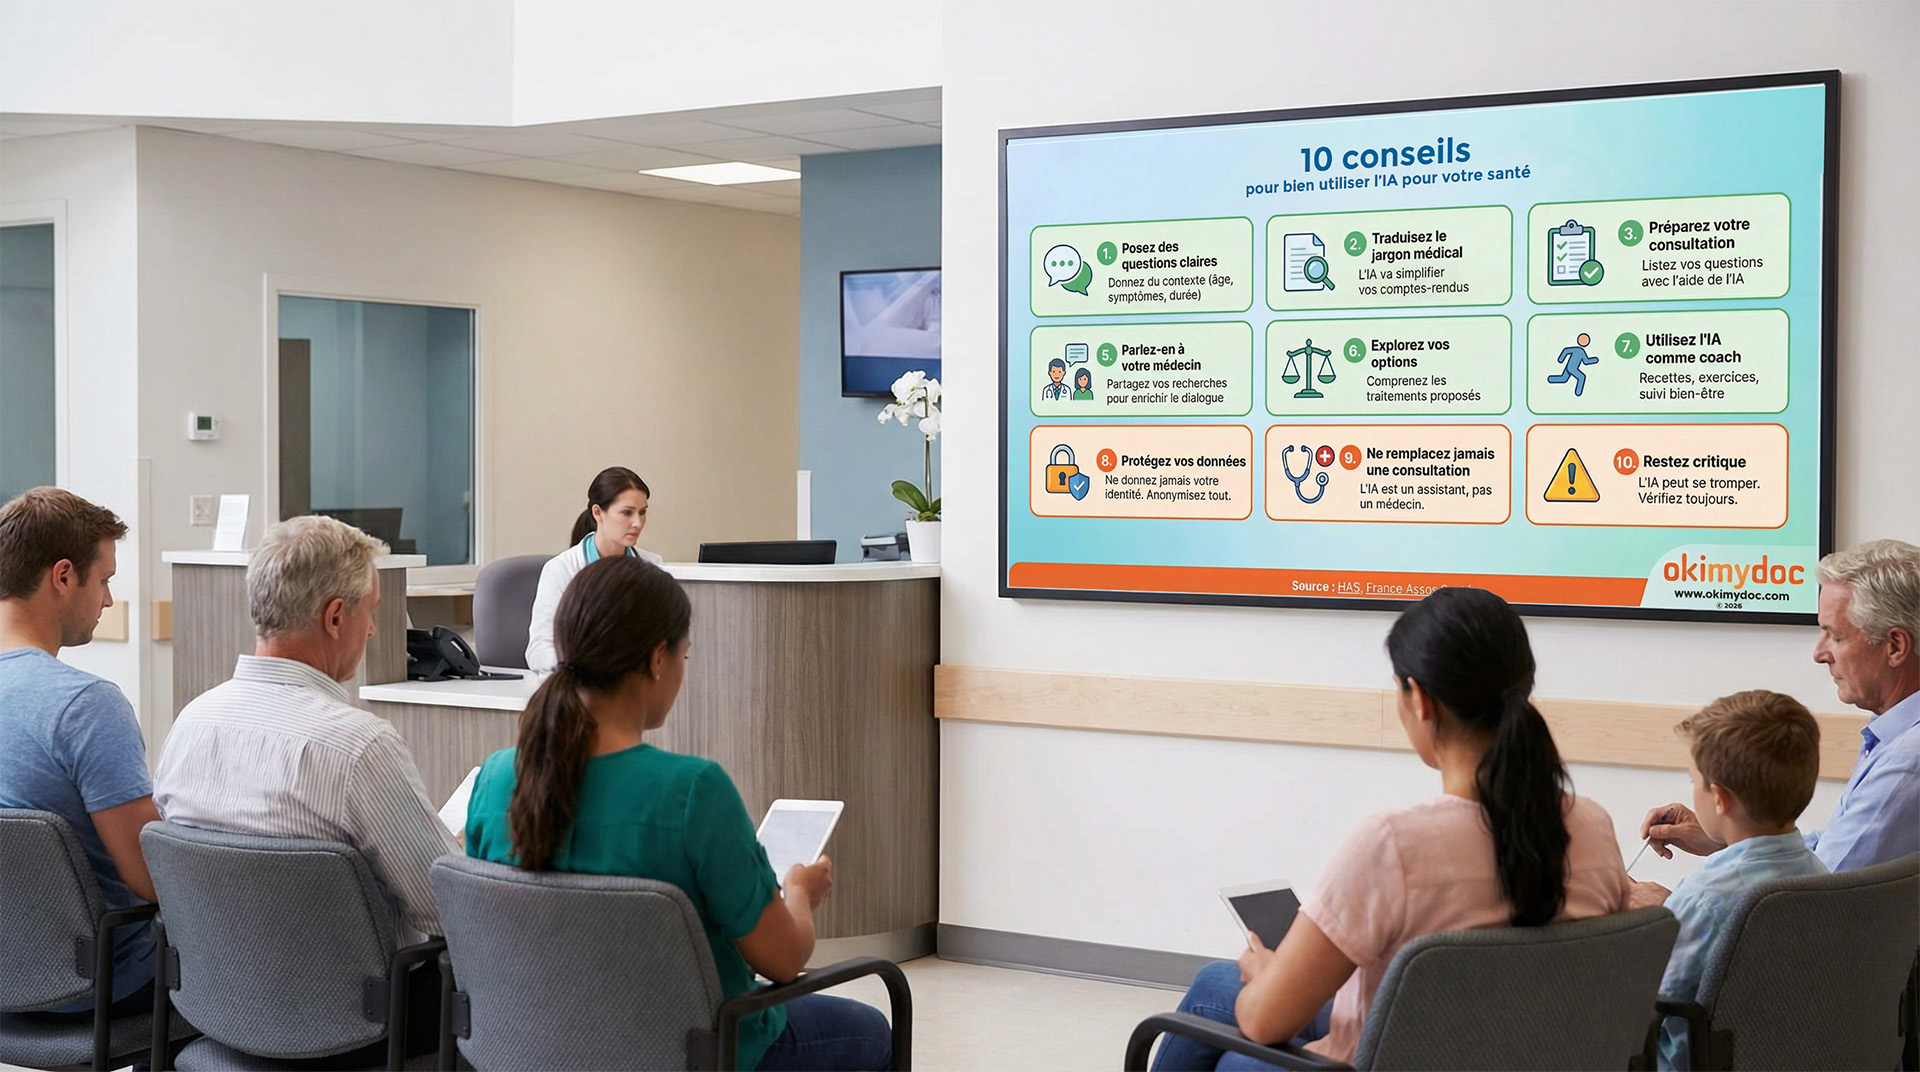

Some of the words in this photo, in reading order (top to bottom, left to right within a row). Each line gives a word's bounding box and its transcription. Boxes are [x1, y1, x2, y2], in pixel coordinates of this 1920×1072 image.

[1300, 146, 1333, 173] 10
[1342, 137, 1471, 169] conseils
[1246, 182, 1279, 197] pour
[1283, 180, 1314, 193] bien
[1319, 176, 1370, 190] utiliser
[1402, 173, 1438, 188] pour
[1442, 170, 1483, 182] votre
[1487, 165, 1531, 180] santé
[1623, 227, 1637, 240] 3.
[1649, 220, 1710, 236] Préparez
[1714, 219, 1750, 231] votre
[1349, 238, 1361, 250] 2.
[1372, 232, 1432, 244] Traduisez
[1436, 230, 1447, 242] le
[1649, 237, 1735, 251] consultation
[1103, 248, 1112, 260] 1.
[1122, 242, 1155, 254] Posez
[1158, 241, 1179, 253] des
[1371, 249, 1410, 264] jargon
[1414, 247, 1463, 260] médical
[1122, 257, 1177, 272] questions
[1180, 256, 1217, 267] claires
[1642, 259, 1677, 271] Listez
[1680, 260, 1700, 270] vos
[1704, 256, 1763, 271] questions
[1108, 277, 1144, 288] Donnez
[1148, 276, 1160, 287] du
[1163, 276, 1205, 286] contexte
[1208, 274, 1233, 286] (âge,
[1380, 270, 1393, 280] va
[1396, 267, 1445, 281] simplifier
[1641, 276, 1669, 287] avec
[1707, 274, 1723, 285] de
[1359, 286, 1377, 295] vos
[1380, 281, 1469, 296] comptes-rendus
[1108, 291, 1166, 304] symptômes,
[1169, 289, 1201, 301] durée)
[1349, 345, 1361, 357] 6.
[1372, 339, 1424, 353] Explorez
[1427, 340, 1450, 350] vos
[1622, 340, 1633, 353] 7.
[1646, 333, 1696, 347] Utilisez
[1101, 349, 1112, 361] 5.
[1122, 344, 1175, 355] Parlez-en
[1178, 343, 1185, 354] à
[1646, 352, 1696, 364] comme
[1699, 351, 1741, 363] coach
[1122, 362, 1150, 372] votre
[1153, 358, 1201, 371] médecin
[1371, 356, 1417, 371] options
[1107, 378, 1149, 390] Partagez
[1152, 380, 1170, 389] vos
[1173, 377, 1227, 389] recherches
[1367, 375, 1428, 388] Comprenez
[1431, 375, 1446, 386] les
[1639, 372, 1695, 385] Recettes,
[1699, 372, 1759, 384] exercices,
[1107, 394, 1128, 405] pour
[1131, 392, 1167, 403] enrichir
[1170, 393, 1179, 403] le
[1182, 392, 1224, 405] dialogue
[1367, 391, 1427, 401] traitements
[1430, 389, 1481, 403] proposés
[1639, 388, 1666, 400] suivi
[1669, 387, 1725, 399] bien-être
[1101, 455, 1112, 466] 8.
[1122, 455, 1171, 469] Protégez
[1174, 457, 1193, 467] vos
[1196, 455, 1246, 467] données
[1344, 451, 1356, 464] 9.
[1367, 447, 1383, 459] Ne
[1386, 447, 1450, 462] remplacez
[1453, 448, 1495, 462] jamais
[1616, 455, 1636, 469] 10.
[1644, 455, 1690, 468] Restez
[1693, 455, 1746, 470] critique
[1367, 466, 1389, 476] une
[1392, 464, 1470, 476] consultation
[1105, 474, 1118, 485] Ne
[1121, 475, 1157, 485] donnez
[1159, 475, 1191, 487] jamais
[1193, 476, 1219, 485] votre
[1662, 478, 1689, 492] peut
[1692, 479, 1706, 489] se
[1710, 477, 1760, 491] tromper.
[1105, 489, 1144, 499] identité.
[1146, 490, 1206, 502] Anonymisez
[1208, 490, 1231, 500] tout.
[1381, 485, 1398, 494] est
[1401, 485, 1414, 494] un
[1417, 484, 1469, 496] assistant,
[1472, 486, 1492, 498] pas
[1360, 500, 1373, 509] un
[1376, 498, 1424, 510] médecin.
[1638, 492, 1683, 504] Vérifiez
[1686, 494, 1738, 507] toujours.
[1664, 553, 1805, 589] okimydoc
[1292, 580, 1329, 592] Source
[1338, 581, 1363, 594] HAS,
[1366, 582, 1403, 595] France
[1674, 590, 1790, 602] www.okimydoc.com
